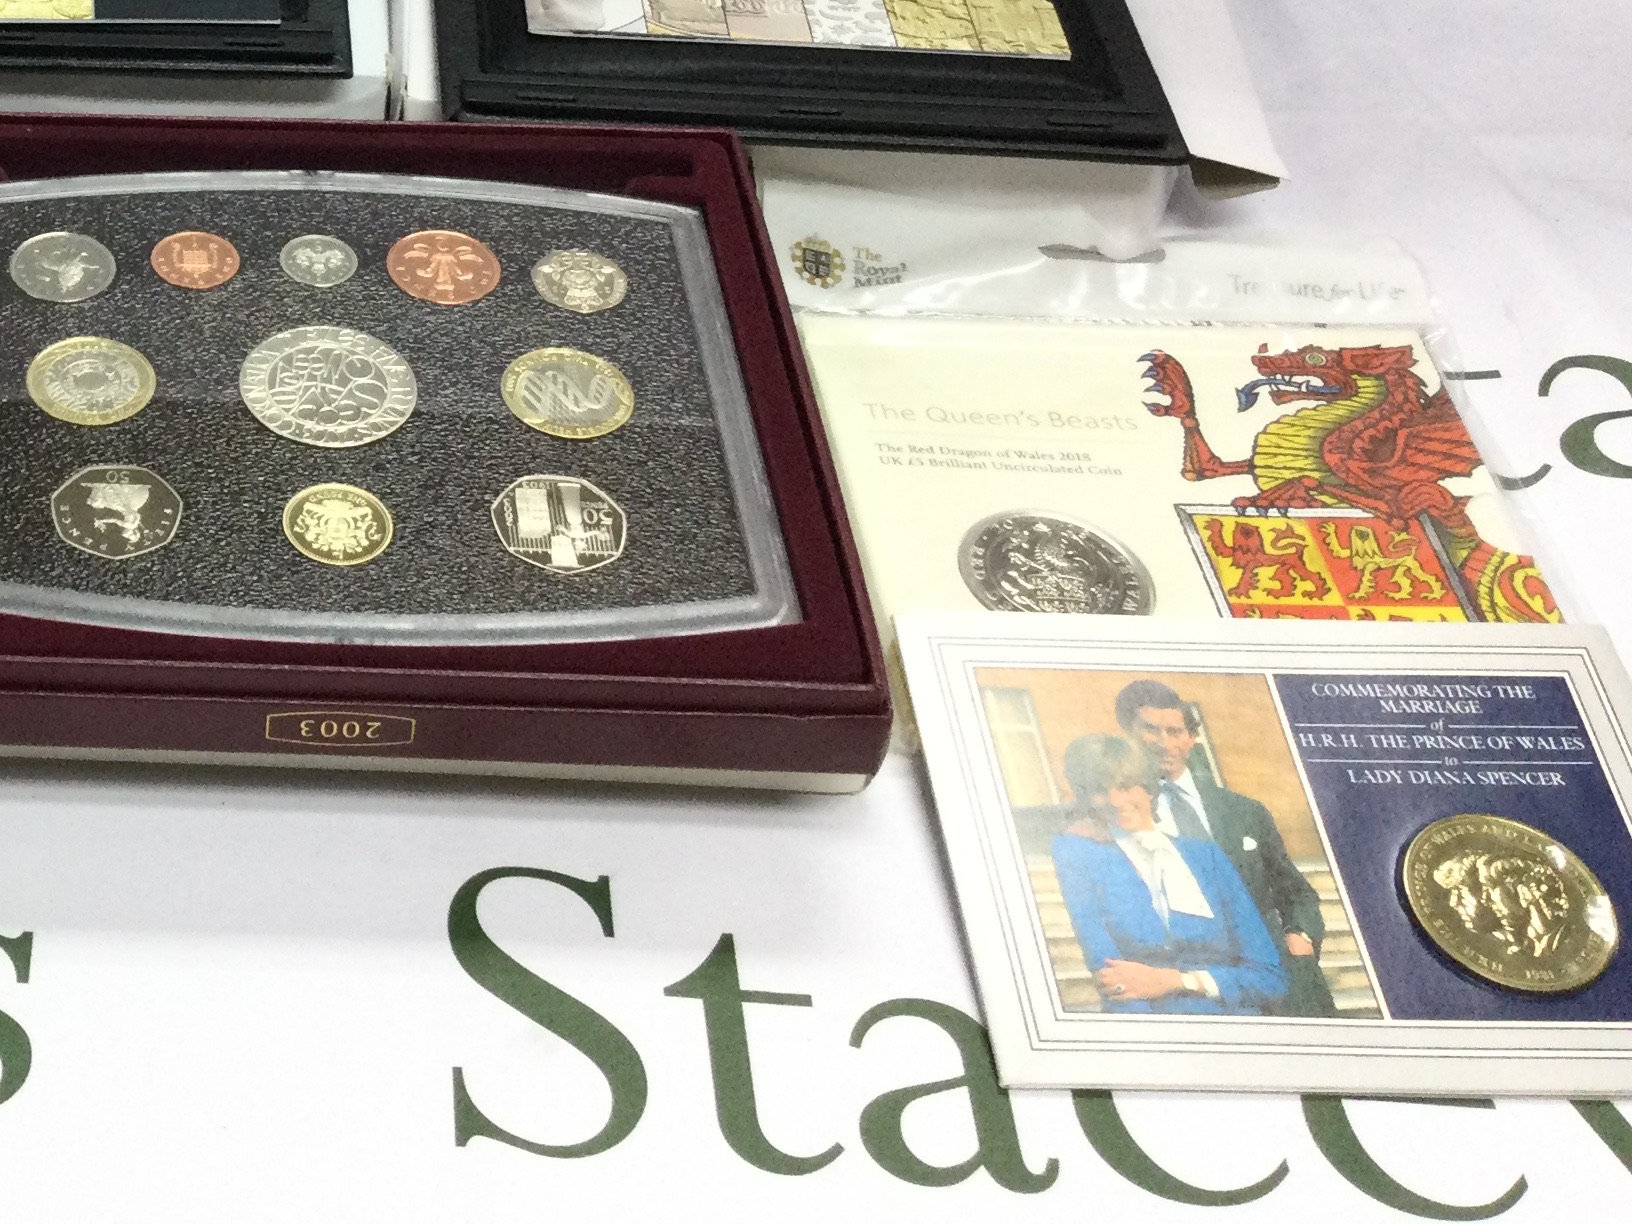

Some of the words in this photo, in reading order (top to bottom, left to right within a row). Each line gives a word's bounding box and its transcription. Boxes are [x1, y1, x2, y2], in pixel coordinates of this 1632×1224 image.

[1227, 272, 1324, 299] Treure
[861, 402, 918, 422] The
[924, 405, 1042, 428] Queen's
[1047, 410, 1140, 432] Beasts
[874, 442, 904, 454] The
[906, 443, 936, 456] Red
[938, 445, 993, 461] Dragon
[995, 447, 1011, 459] of
[1013, 448, 1056, 462] Wales
[1058, 450, 1093, 463] 2018
[878, 454, 904, 467] UK
[928, 457, 989, 472] Brilliant
[991, 460, 1085, 476] Uncirculated
[1086, 463, 1124, 477] Coin
[105, 470, 130, 484] 50
[582, 508, 614, 526] 50
[1310, 682, 1492, 699] COMMEMORATING
[1492, 684, 1538, 700] THE
[1380, 699, 1484, 715] MARRIAGE
[299, 718, 383, 740] 2003
[1429, 717, 1446, 732] of
[1367, 733, 1410, 750] THE
[1412, 734, 1487, 750] PRINCE
[1486, 735, 1514, 751] OF
[1516, 736, 1586, 752] WALES
[1443, 755, 1459, 767] to
[1346, 768, 1405, 784] LADY
[1407, 769, 1477, 785] DIANA
[1476, 770, 1568, 787] SPENCER
[447, 866, 1632, 1223] Stace
